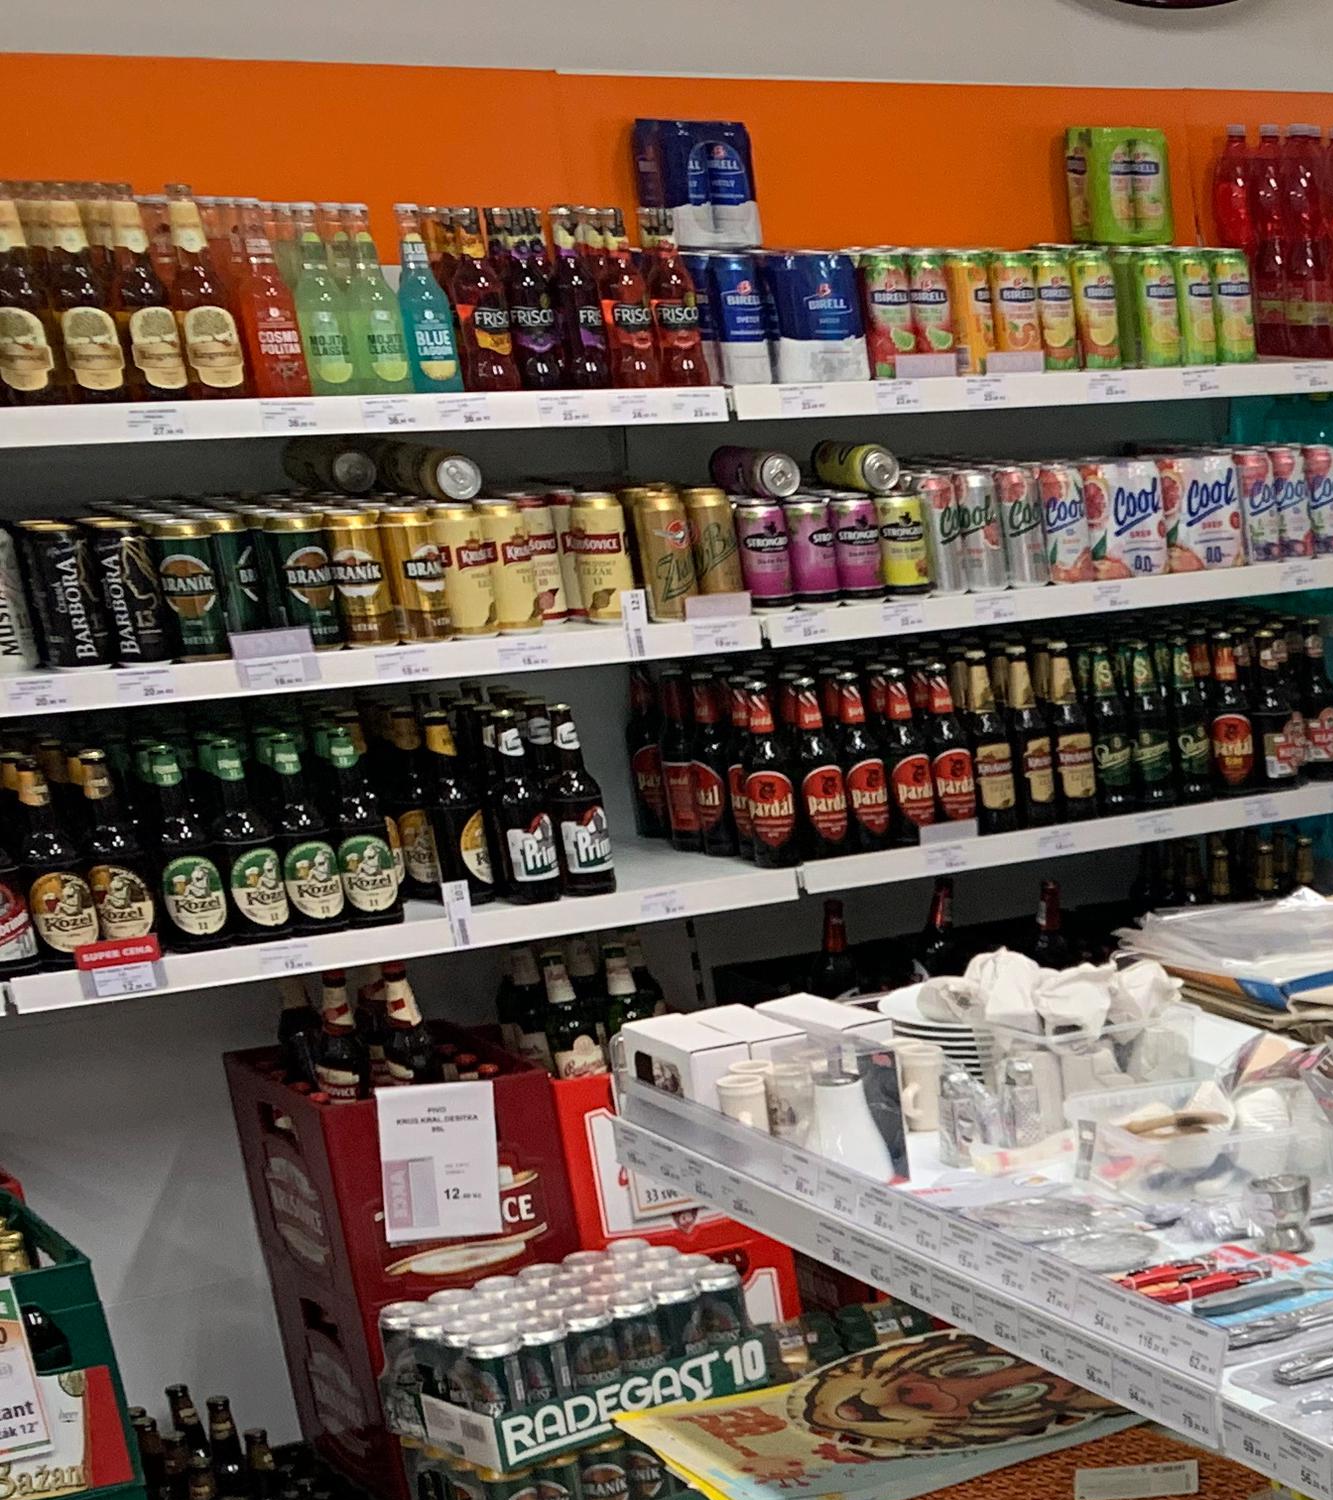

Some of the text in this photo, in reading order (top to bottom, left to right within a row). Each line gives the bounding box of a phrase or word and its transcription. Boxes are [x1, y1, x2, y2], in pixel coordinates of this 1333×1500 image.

[510, 307, 554, 329] FRISCO
[258, 331, 299, 345] COSMO
[416, 331, 451, 347] BLUE
[1186, 465, 1236, 527] Cool
[1113, 476, 1161, 537] Cool
[61, 556, 99, 660] BARBORA
[111, 553, 141, 656] BARBORA
[296, 881, 341, 899] Kozel
[348, 875, 392, 892] Kozel
[174, 898, 222, 915] Kozel
[44, 915, 94, 932] Kozel
[81, 946, 153, 964] SUPER CENA
[502, 1340, 767, 1466] RADEGAST 10
